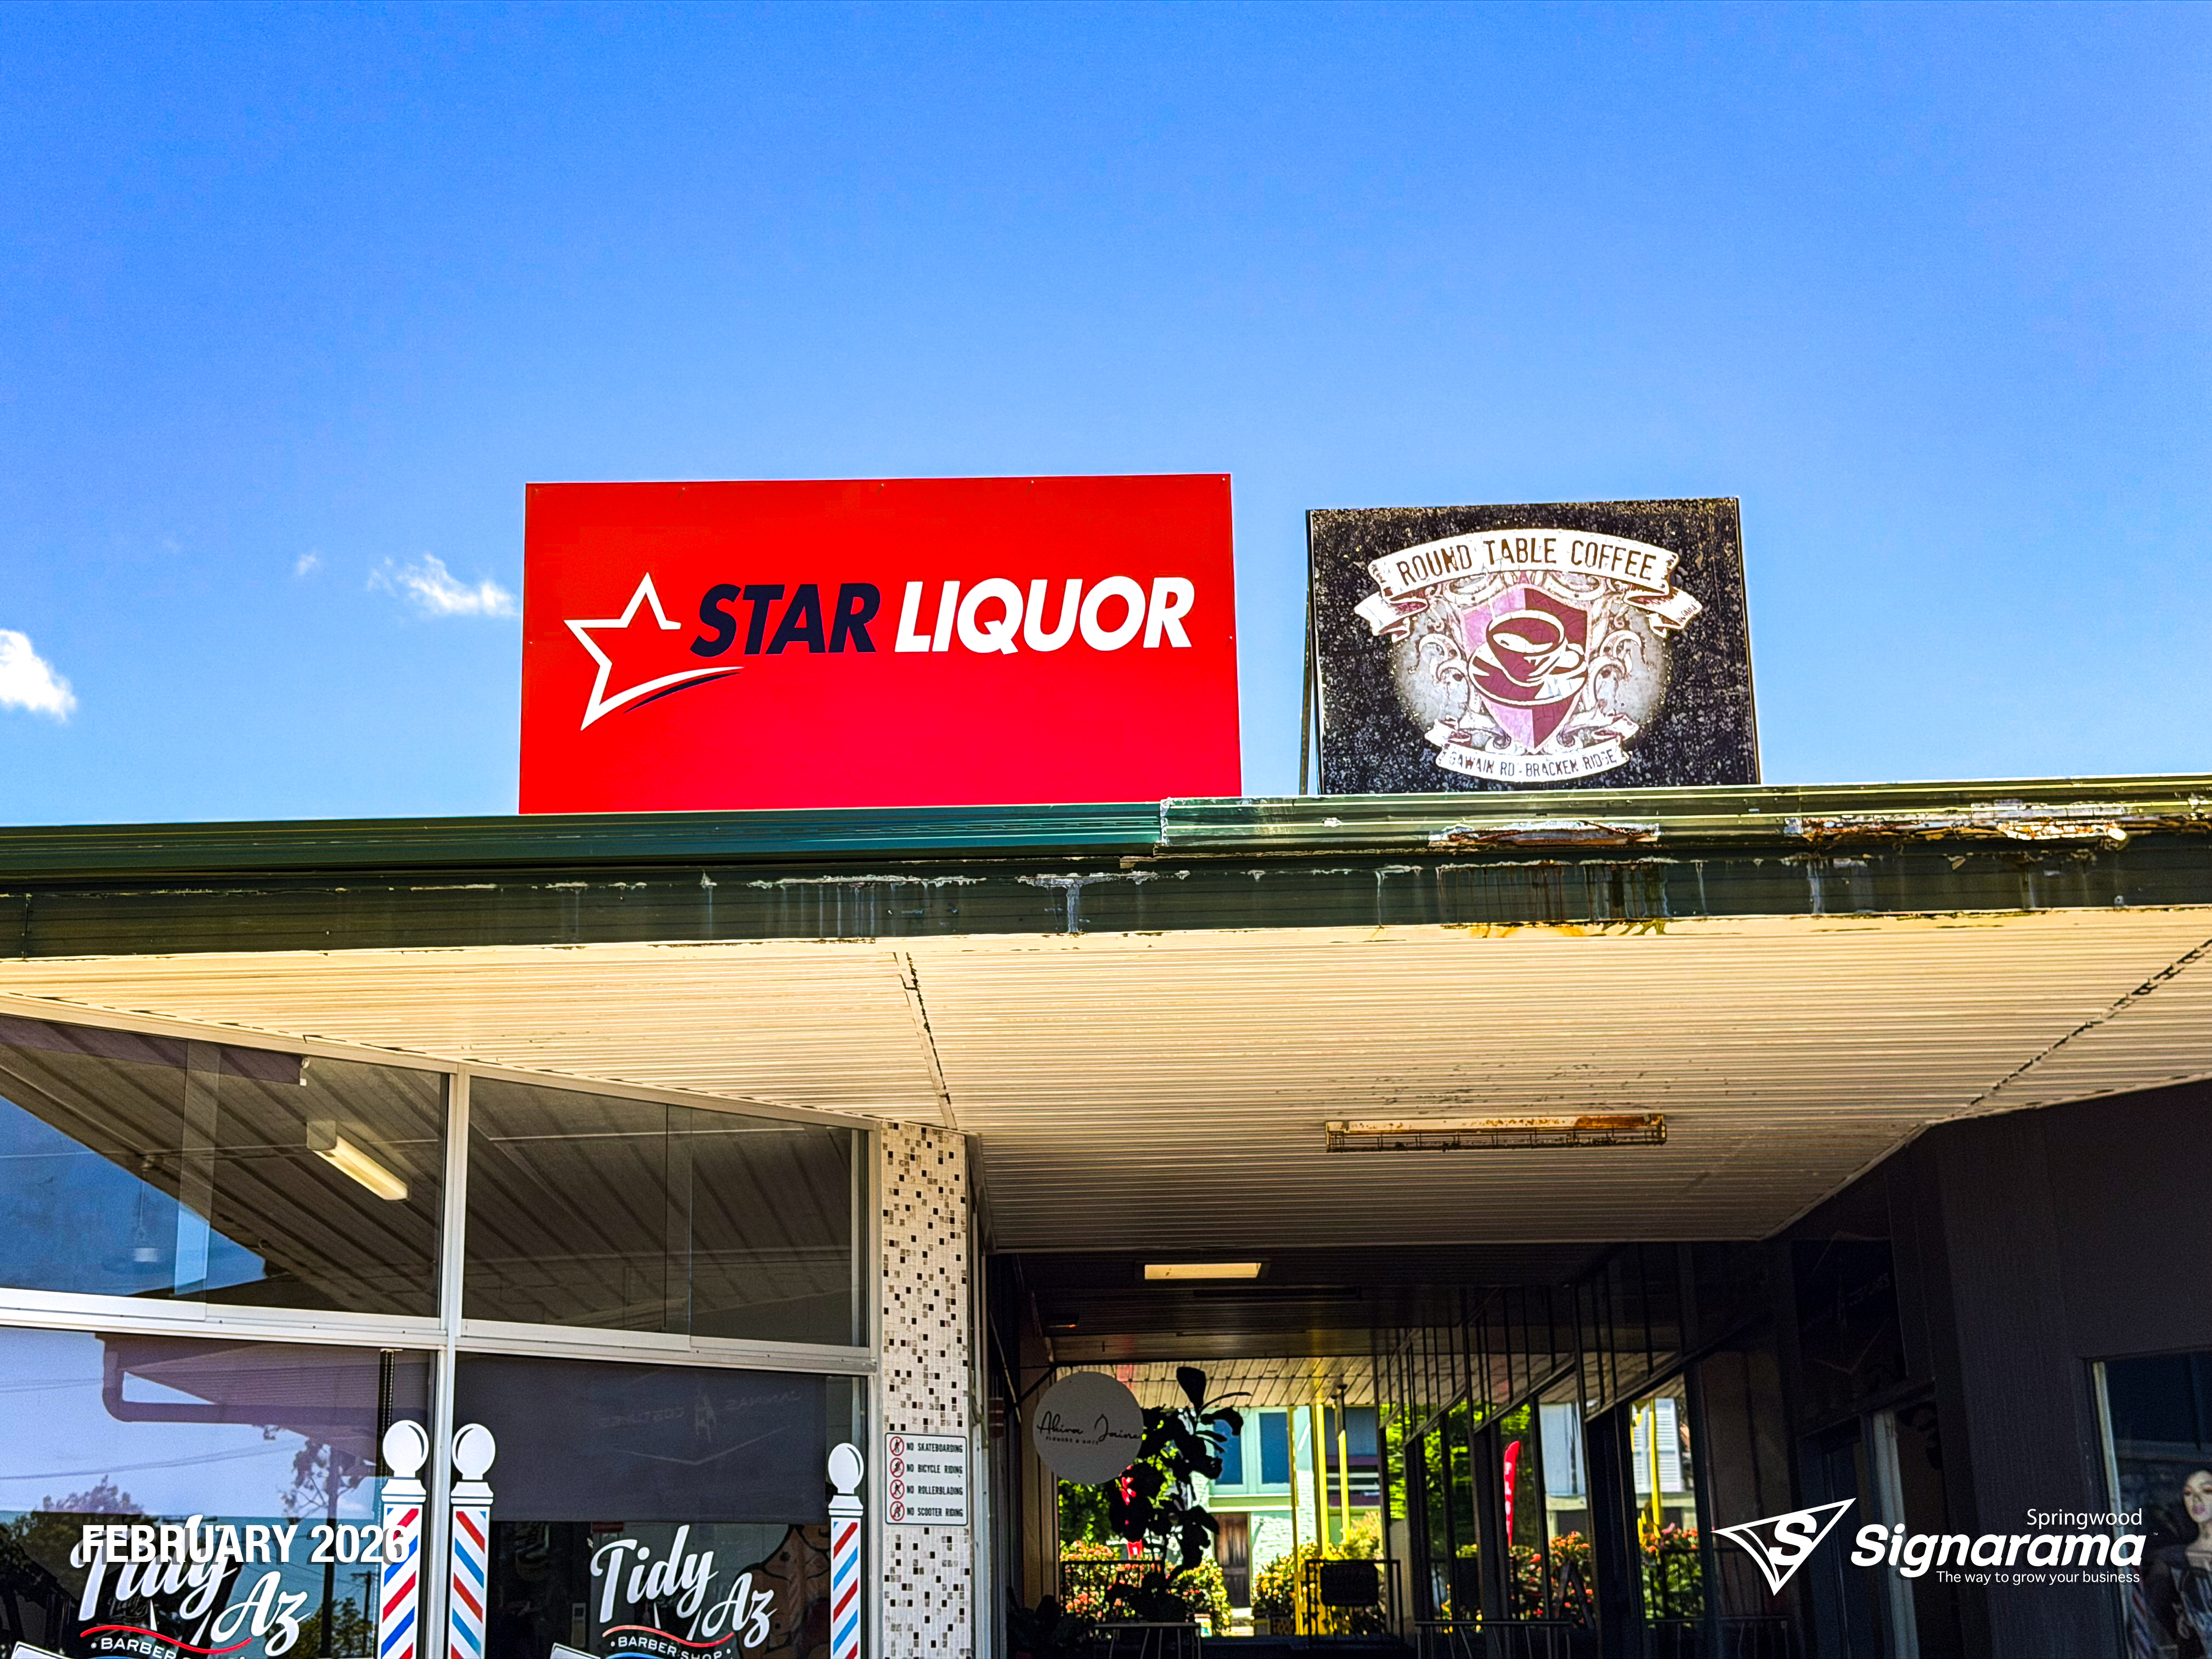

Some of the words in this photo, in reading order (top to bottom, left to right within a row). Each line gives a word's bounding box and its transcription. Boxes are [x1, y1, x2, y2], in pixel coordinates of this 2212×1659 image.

[1397, 544, 1472, 586] ROUND
[1483, 537, 1557, 566] TABLE
[1571, 540, 1657, 581] COFFEE
[690, 583, 881, 657] STAR
[895, 575, 1196, 655] LIQUOR
[1500, 761, 1515, 776] RD
[1526, 760, 1579, 777] BRACKEN
[906, 1442, 914, 1451] NO
[906, 1464, 915, 1472] NO
[906, 1485, 915, 1494] NO
[906, 1507, 915, 1516] NO
[590, 1525, 719, 1623] Tidy
[701, 1573, 777, 1648] Az
[210, 1571, 313, 1656] Az
[101, 1638, 177, 1659] BARBER
[618, 1636, 677, 1656] BARBER
